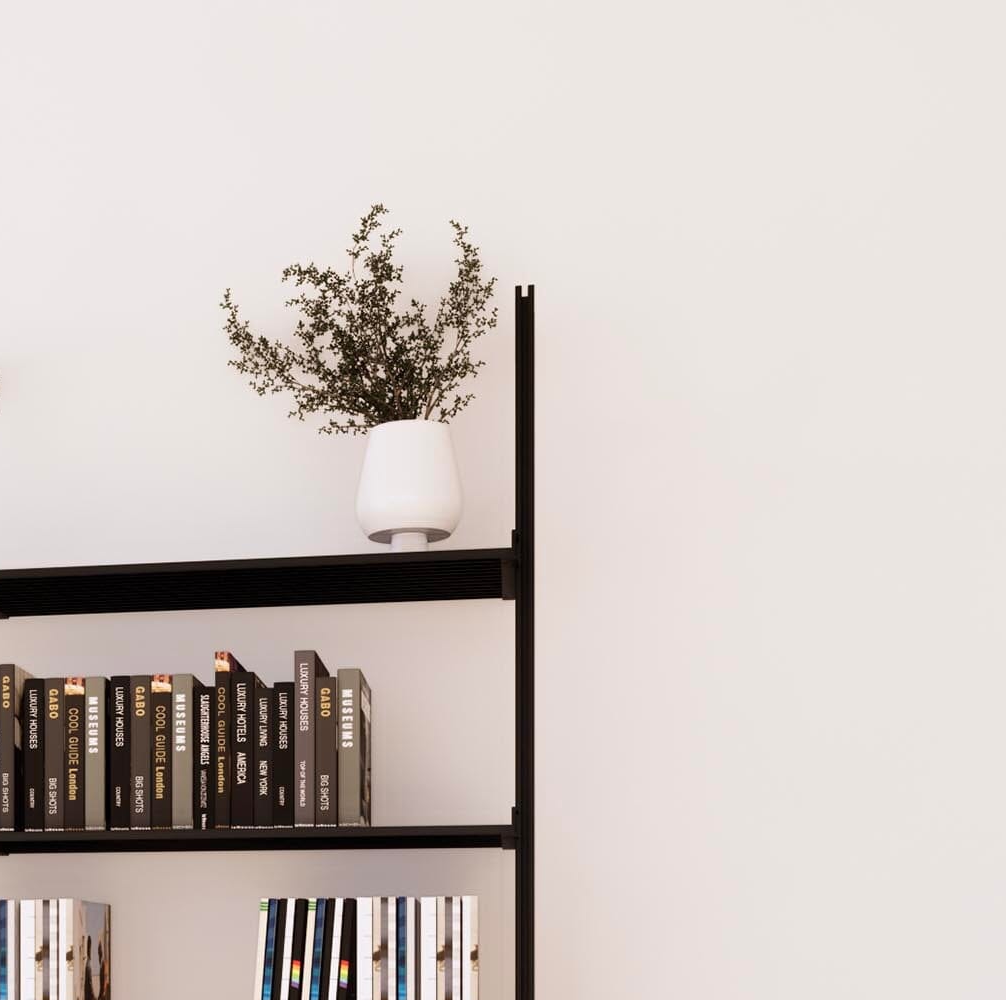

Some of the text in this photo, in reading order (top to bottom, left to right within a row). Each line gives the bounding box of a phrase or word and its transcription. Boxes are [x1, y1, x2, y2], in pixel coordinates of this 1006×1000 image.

[2, 675, 10, 708] GABO
[48, 688, 59, 719] GABO
[135, 685, 145, 717] GABO
[236, 682, 246, 743] LUXURY HOTELS
[299, 662, 309, 732] LUXURY HOUSES
[320, 687, 331, 718] GABO
[29, 689, 38, 750] LUXURY HOUSES
[88, 696, 99, 754] MUSEUMS
[115, 687, 125, 748] LUXURY HOUSES
[175, 694, 186, 753] MUSEUMS
[200, 694, 210, 743] SLAUGHTERHOUSE
[217, 686, 226, 794] COOL GUIDE London
[259, 697, 268, 747] LUXURY LIVING
[278, 692, 288, 750] LUXURY HOUSES
[341, 688, 353, 749] MUSEUMS
[68, 707, 79, 801] COOL GUIDE London
[155, 705, 166, 800] COOL GUIDE London
[200, 744, 210, 766] ANGELS
[236, 751, 247, 785] AMERICA
[48, 777, 57, 815] BIG SHOTS
[135, 775, 144, 814] BIG SHOTS
[259, 760, 268, 796] NEW YORK
[320, 774, 329, 811] BIG SHOTS
